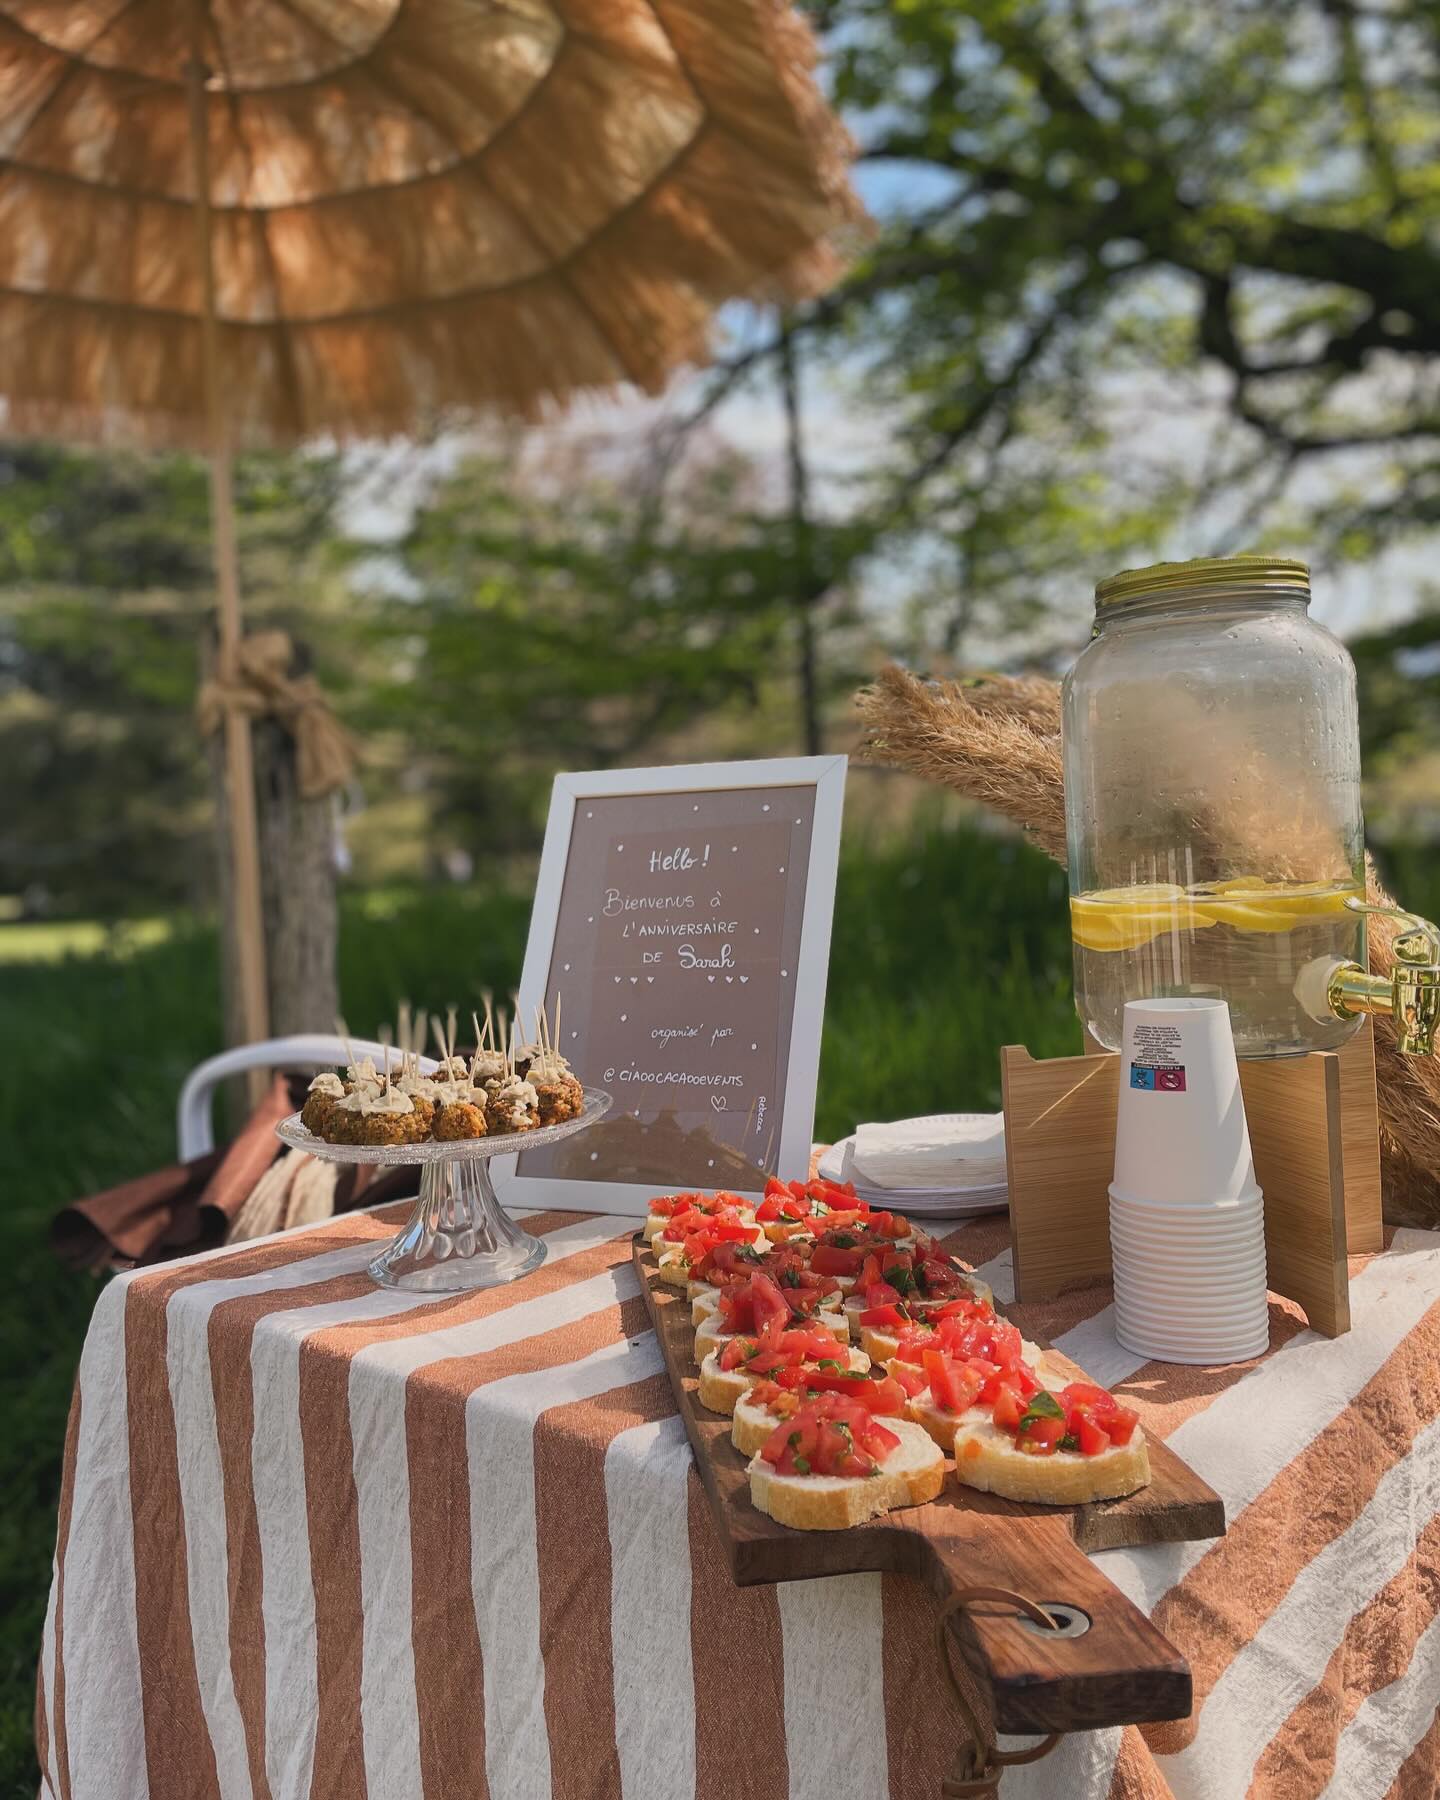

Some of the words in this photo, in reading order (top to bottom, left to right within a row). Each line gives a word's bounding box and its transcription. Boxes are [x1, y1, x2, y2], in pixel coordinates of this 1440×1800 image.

[650, 847, 698, 872] Hello
[602, 888, 695, 917] Bienvenus
[710, 890, 722, 908] à
[643, 951, 663, 964] DE
[678, 943, 735, 969] Sarah
[651, 1023, 704, 1049] organisé
[710, 1027, 734, 1047] par
